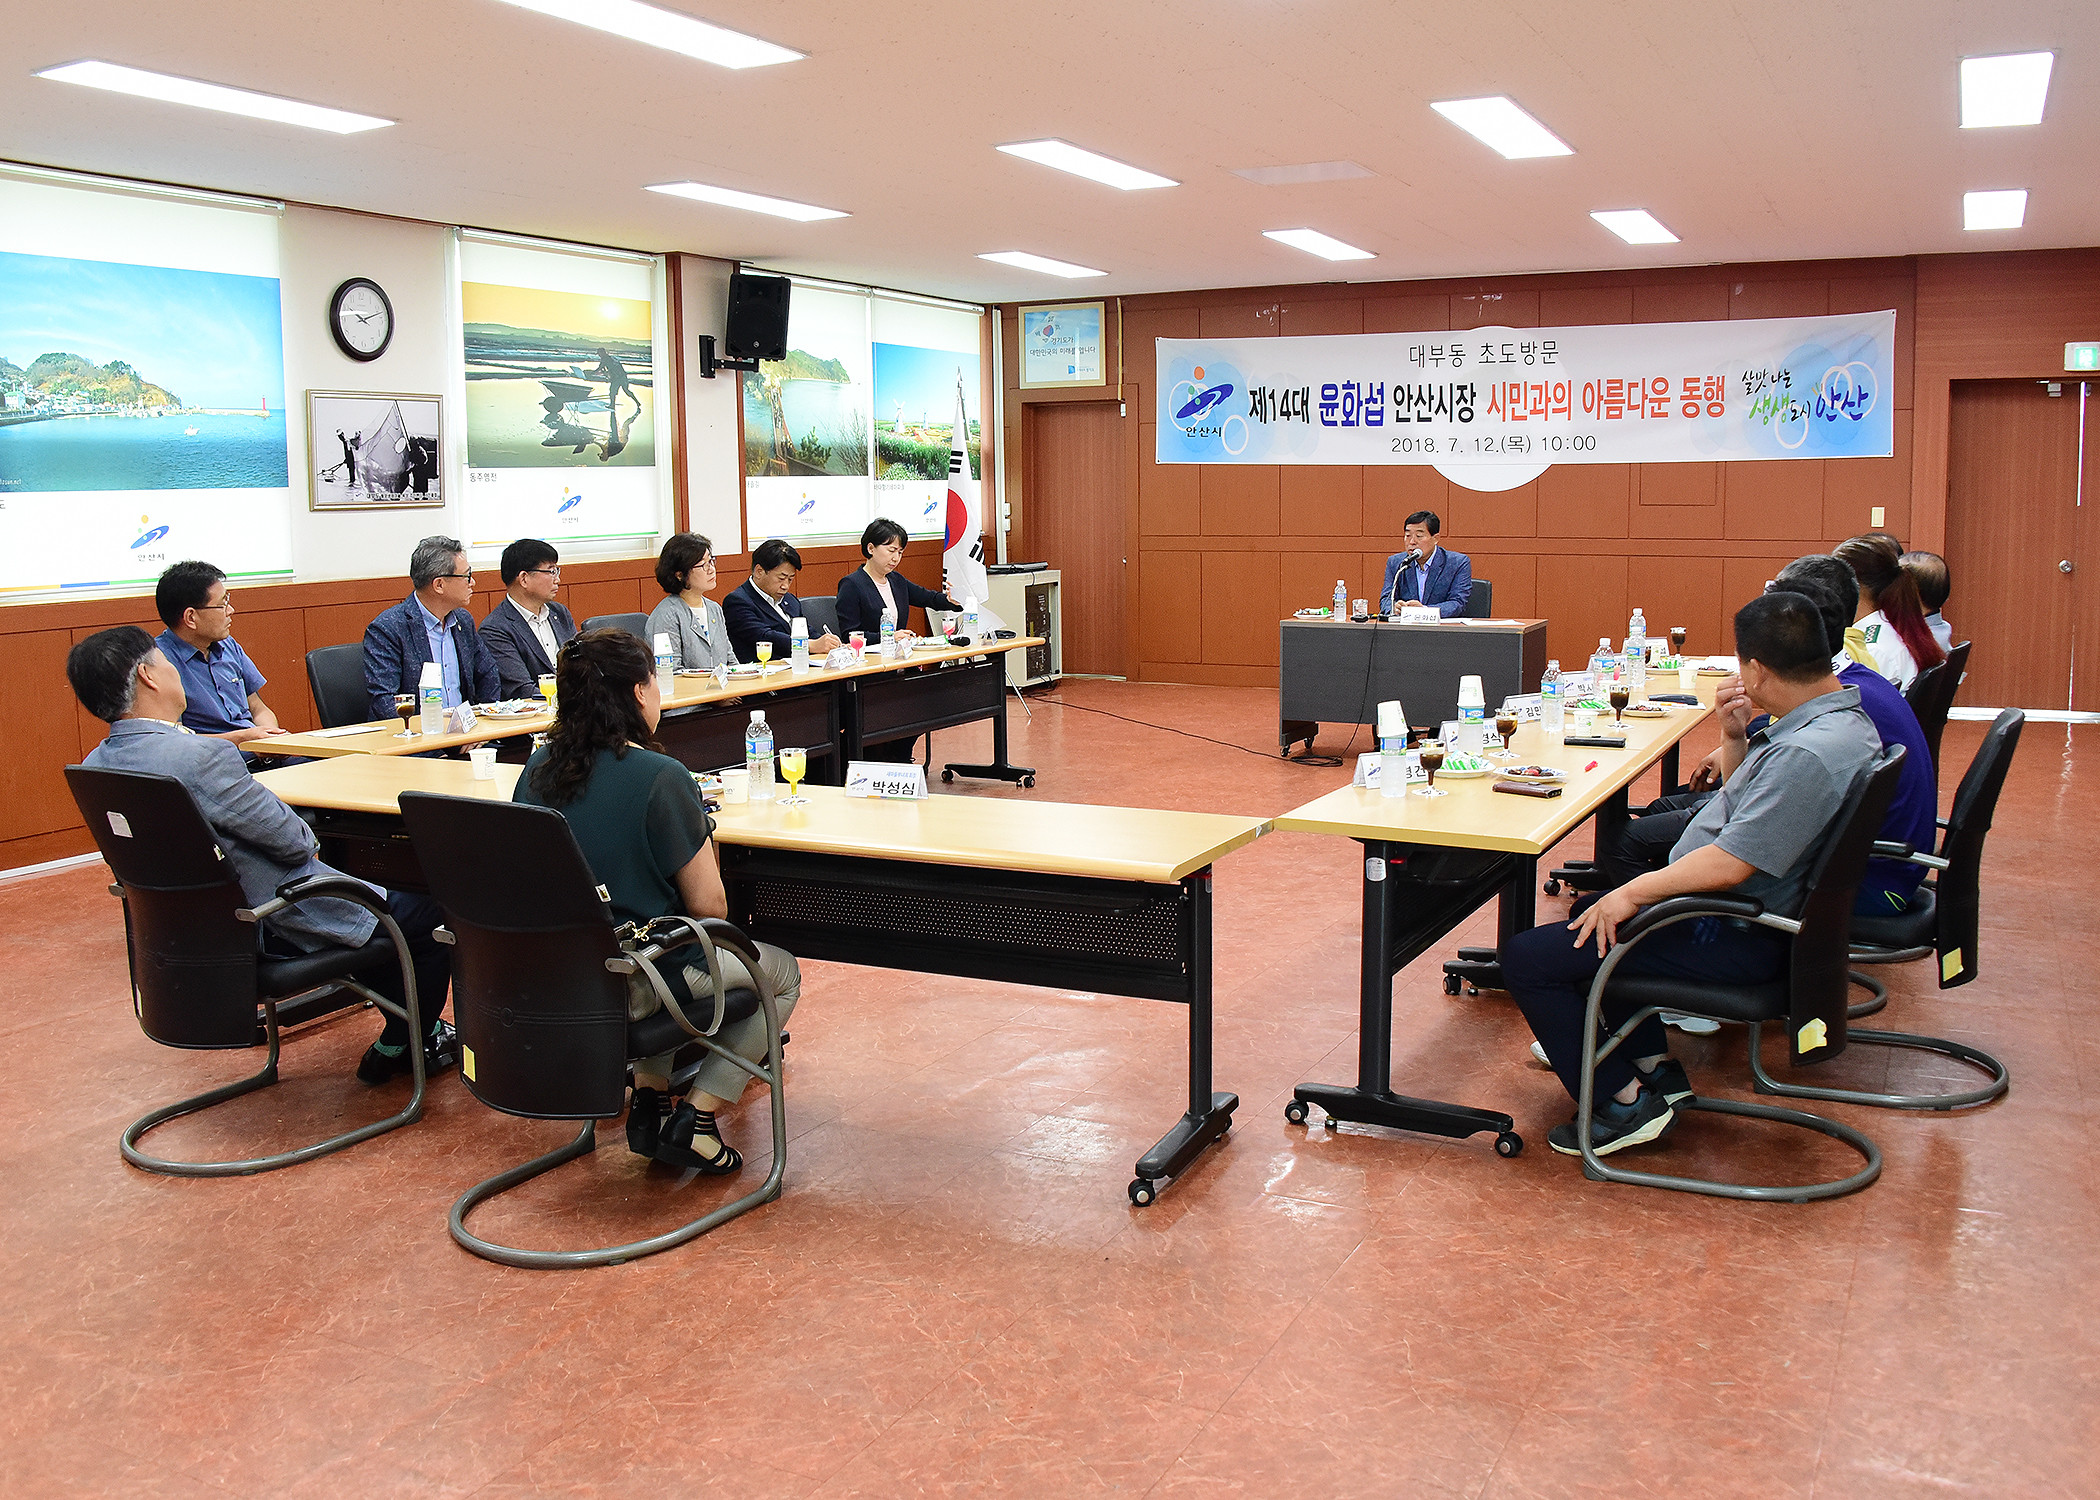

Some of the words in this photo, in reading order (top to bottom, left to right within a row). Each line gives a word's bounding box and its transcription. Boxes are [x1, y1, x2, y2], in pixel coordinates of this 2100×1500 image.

[1408, 344, 1466, 369] 대부동
[1478, 339, 1560, 366] 초도방문
[1248, 384, 1312, 425] 제14대
[1317, 378, 1385, 428] 윤화섭
[1392, 382, 1477, 424] 안산시장
[1486, 378, 1573, 424] 시민과의
[1581, 375, 1671, 421] 아름다운
[1679, 374, 1726, 420] 동행
[1815, 384, 1870, 422] 안산
[1184, 425, 1223, 438] 안산시
[1541, 435, 1597, 452] 10:00
[872, 780, 916, 796] 박성심
